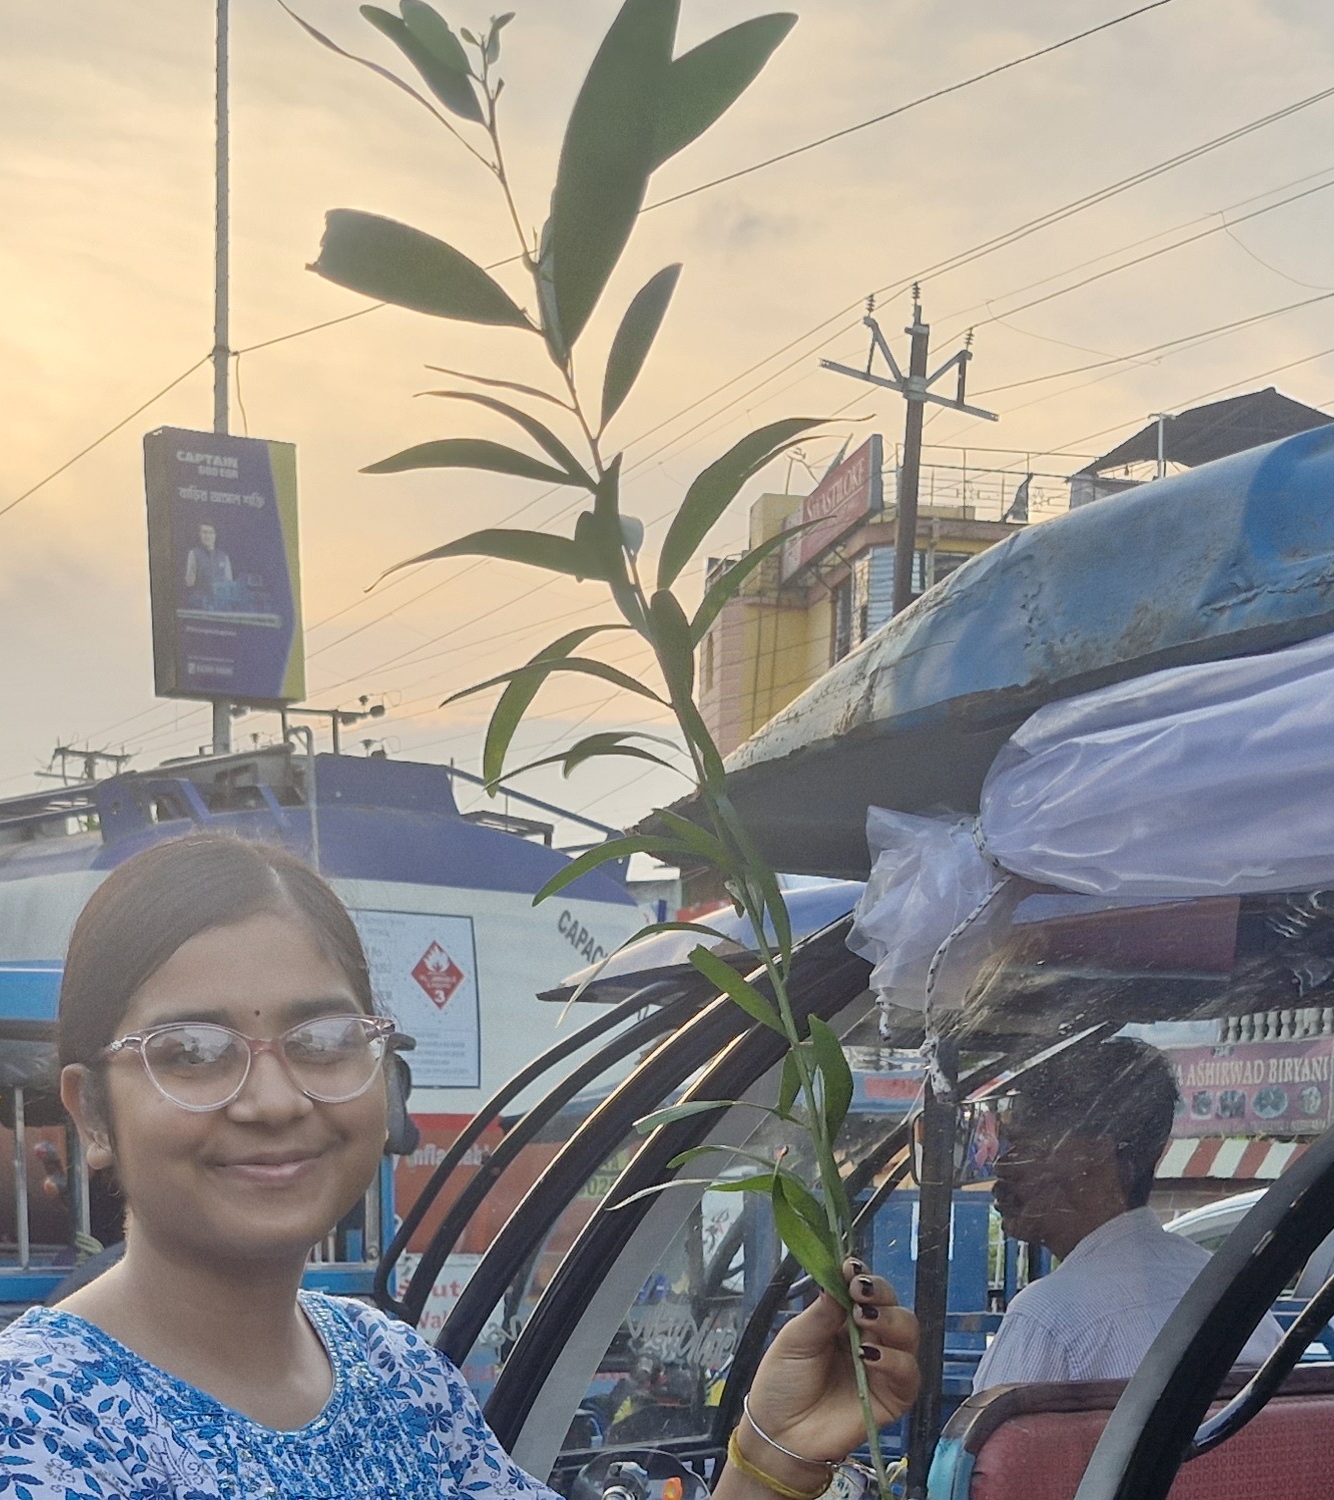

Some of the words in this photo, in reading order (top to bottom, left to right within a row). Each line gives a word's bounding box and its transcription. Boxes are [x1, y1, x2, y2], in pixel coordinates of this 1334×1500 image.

[176, 450, 238, 468] CAPTAIN
[557, 909, 609, 964] CAPAC
[434, 989, 446, 1003] 3
[1186, 1058, 1265, 1087] ASHIRWAD
[1269, 1055, 1330, 1085] BIRYANI
